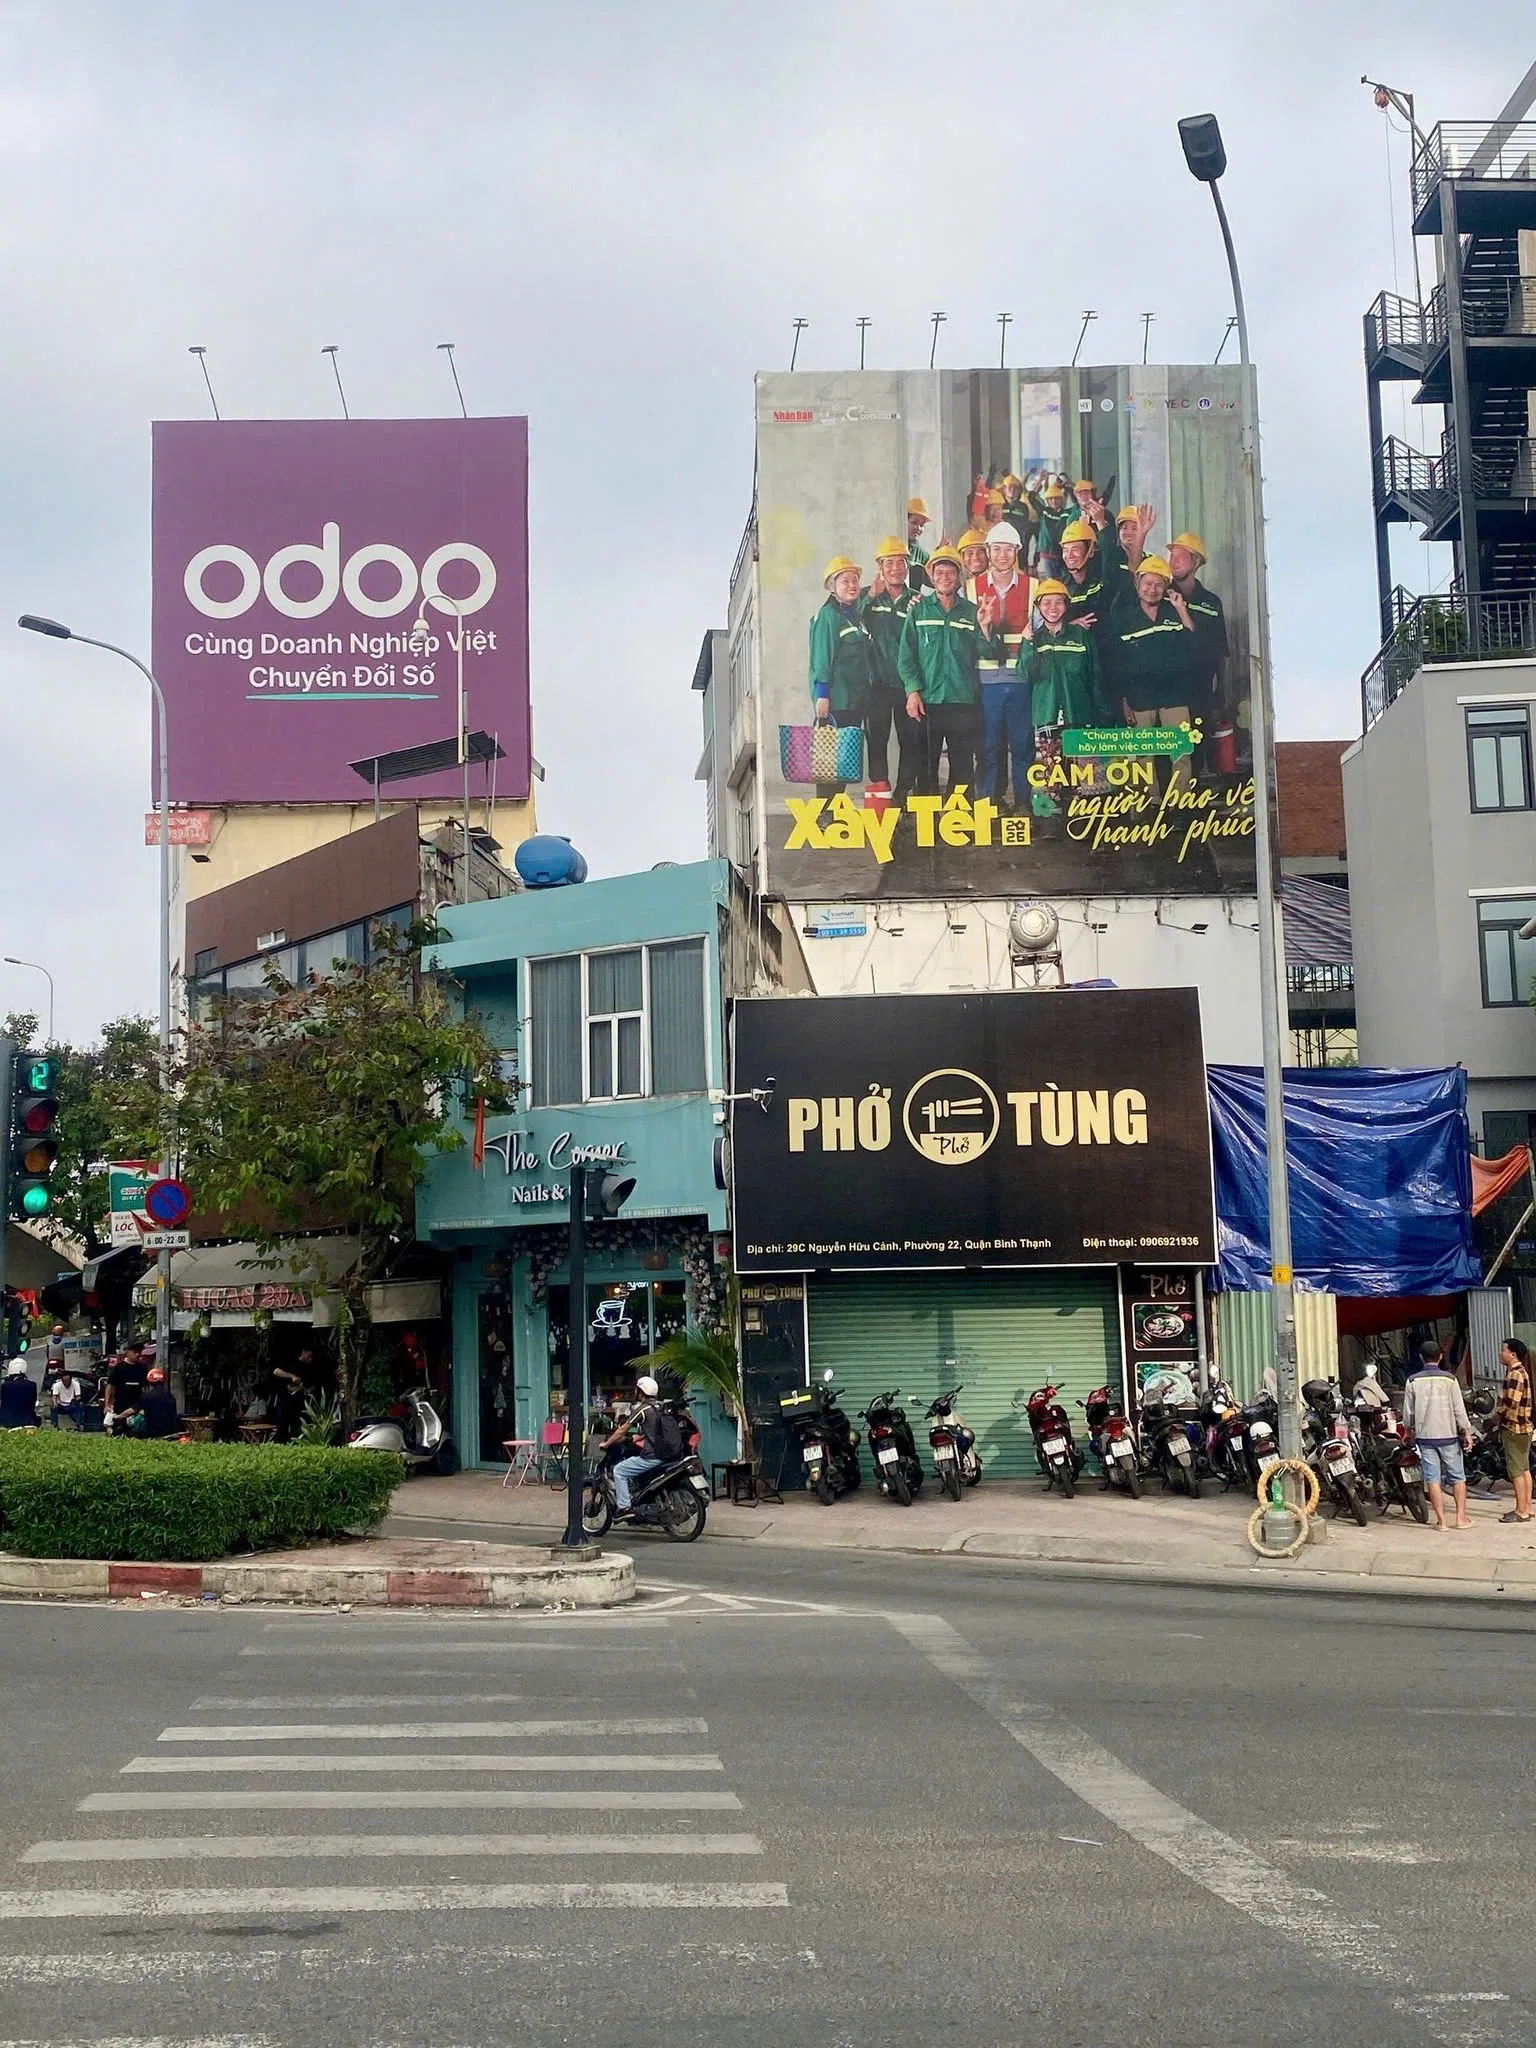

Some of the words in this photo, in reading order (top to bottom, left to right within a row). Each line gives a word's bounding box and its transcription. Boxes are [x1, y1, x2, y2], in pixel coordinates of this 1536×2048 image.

[184, 521, 497, 619] odoo
[184, 631, 253, 660] Cùng
[261, 633, 343, 655] Doanh
[350, 630, 440, 658] Nghiệp
[447, 630, 497, 656] Việt
[249, 663, 347, 692] Chuyển
[352, 664, 396, 687] Đổi
[402, 662, 436, 686] Số
[1078, 742, 1096, 753] hãy
[1099, 742, 1117, 751] làm
[1120, 742, 1138, 752] việc
[1121, 730, 1133, 739] tôi
[1027, 756, 1094, 788] CẢM
[1106, 759, 1154, 786] ƠN
[1066, 784, 1153, 841] người
[1160, 770, 1219, 812] bảo
[784, 792, 901, 865] Xây
[906, 784, 999, 848] Tết
[1092, 810, 1175, 851] hạnh
[1177, 809, 1256, 864] phúc
[788, 1083, 892, 1152] PHỞ
[1007, 1082, 1149, 1147] TÙNG
[484, 1130, 539, 1175] The
[548, 1131, 626, 1170] Corner
[933, 1136, 970, 1156] Phở
[511, 1183, 550, 1203] Nails
[551, 1183, 565, 1201] &
[746, 1243, 763, 1256] Địa
[786, 1242, 806, 1253] 29C
[808, 1241, 846, 1254] Nguyễn
[849, 1241, 870, 1252] Hữu
[872, 1240, 902, 1252] Cảnh,
[904, 1240, 945, 1251] Phường
[947, 1239, 963, 1251] 22,
[964, 1239, 992, 1251] Quận
[994, 1238, 1017, 1249] Bình
[1019, 1238, 1052, 1250] Thạnh
[1082, 1237, 1106, 1249] Điện
[1108, 1237, 1138, 1249] thoại:
[1140, 1236, 1199, 1247] 0906921936
